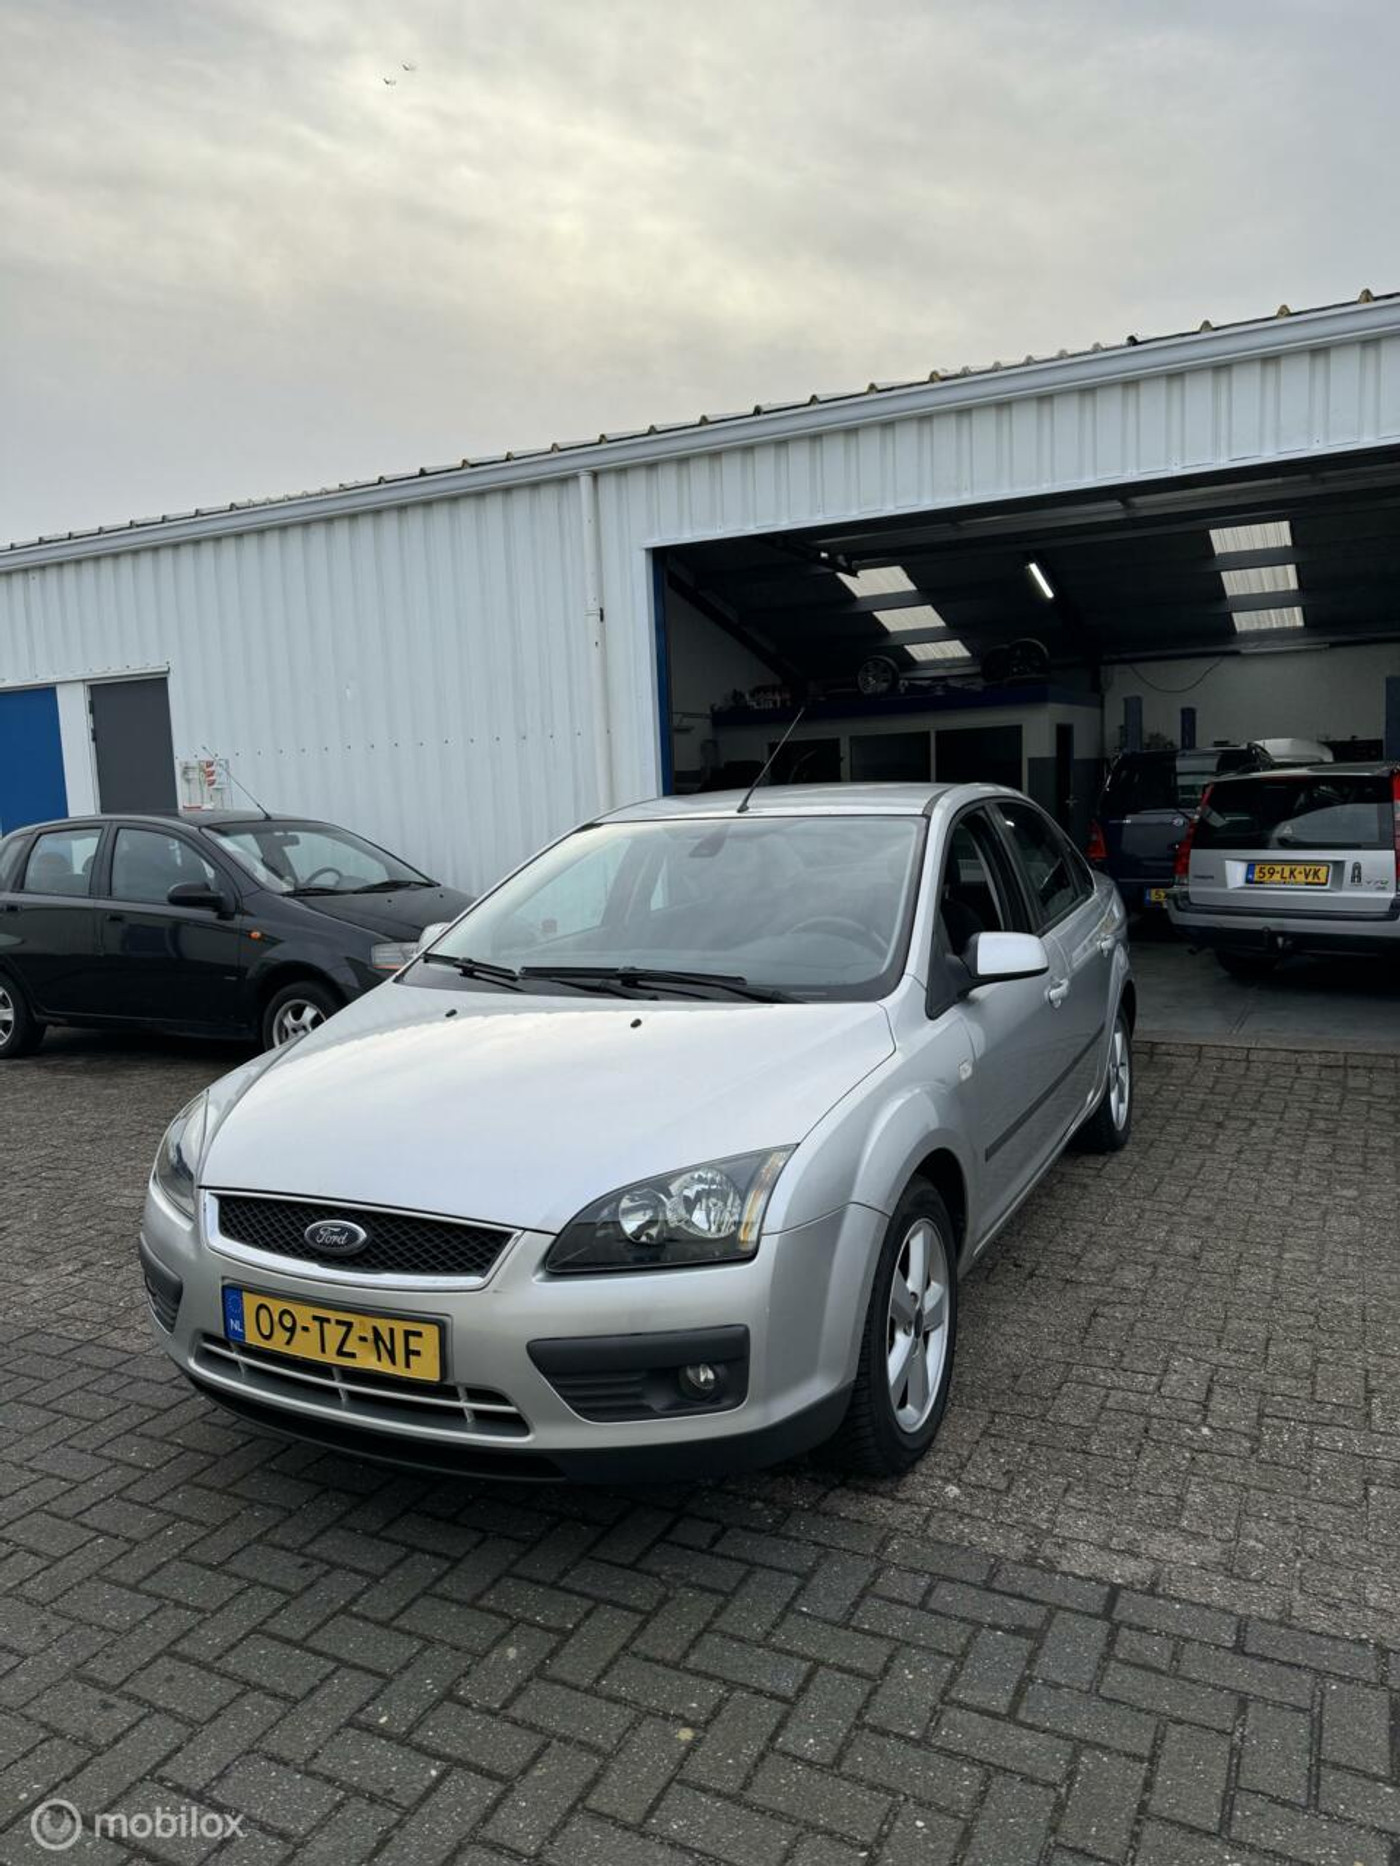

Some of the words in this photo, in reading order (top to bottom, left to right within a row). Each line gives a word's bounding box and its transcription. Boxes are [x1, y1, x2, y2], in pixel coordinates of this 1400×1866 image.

[1258, 866, 1321, 880] 59-LK-VK
[316, 1226, 348, 1245] Ford
[230, 1318, 243, 1333] NL
[255, 1303, 423, 1369] 09-TZ-NF
